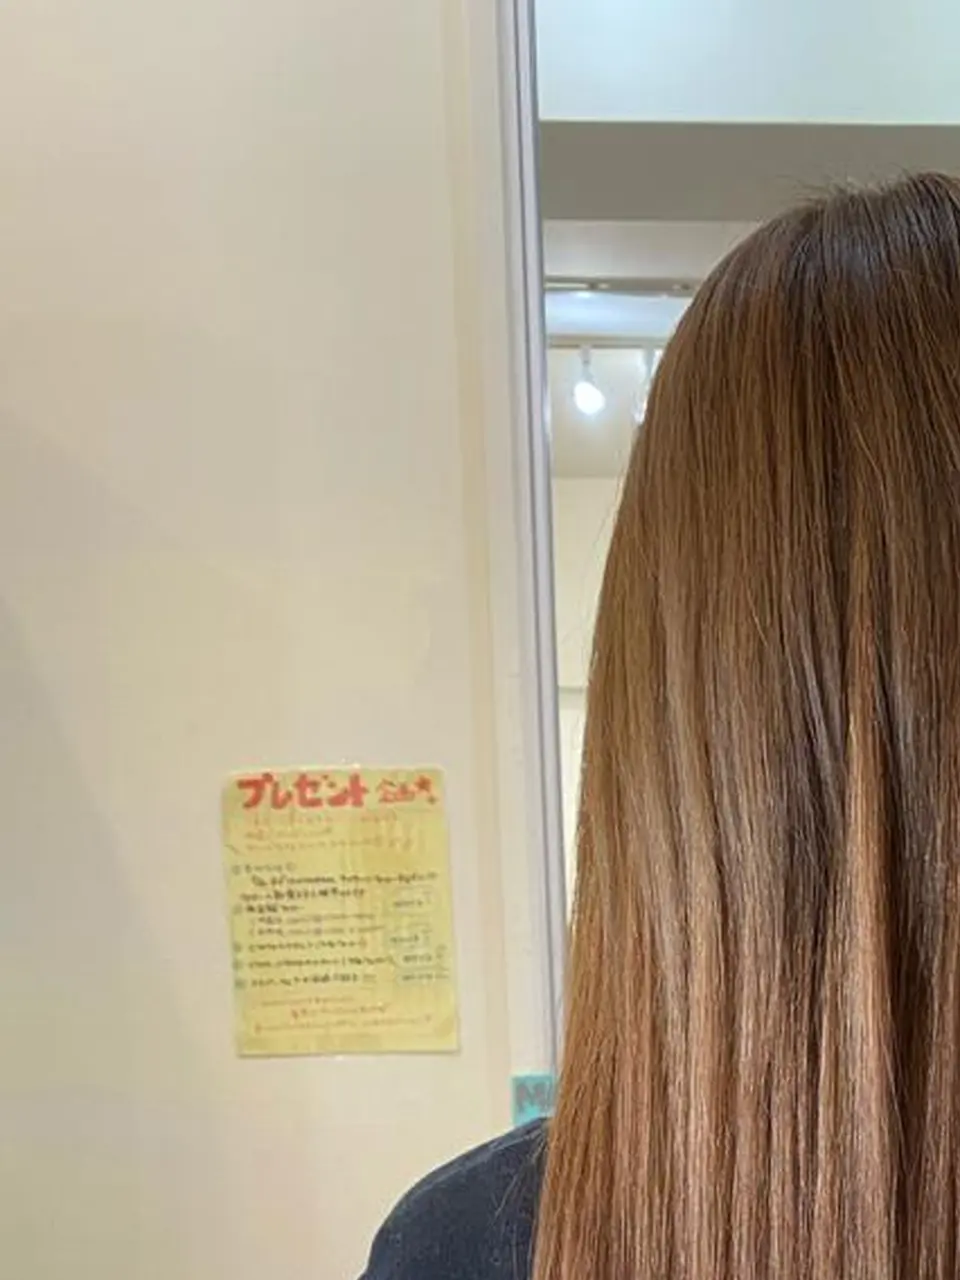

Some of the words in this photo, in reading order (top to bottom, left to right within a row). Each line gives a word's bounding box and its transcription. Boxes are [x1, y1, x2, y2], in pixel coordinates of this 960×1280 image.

[236, 773, 369, 809] プレゼント
